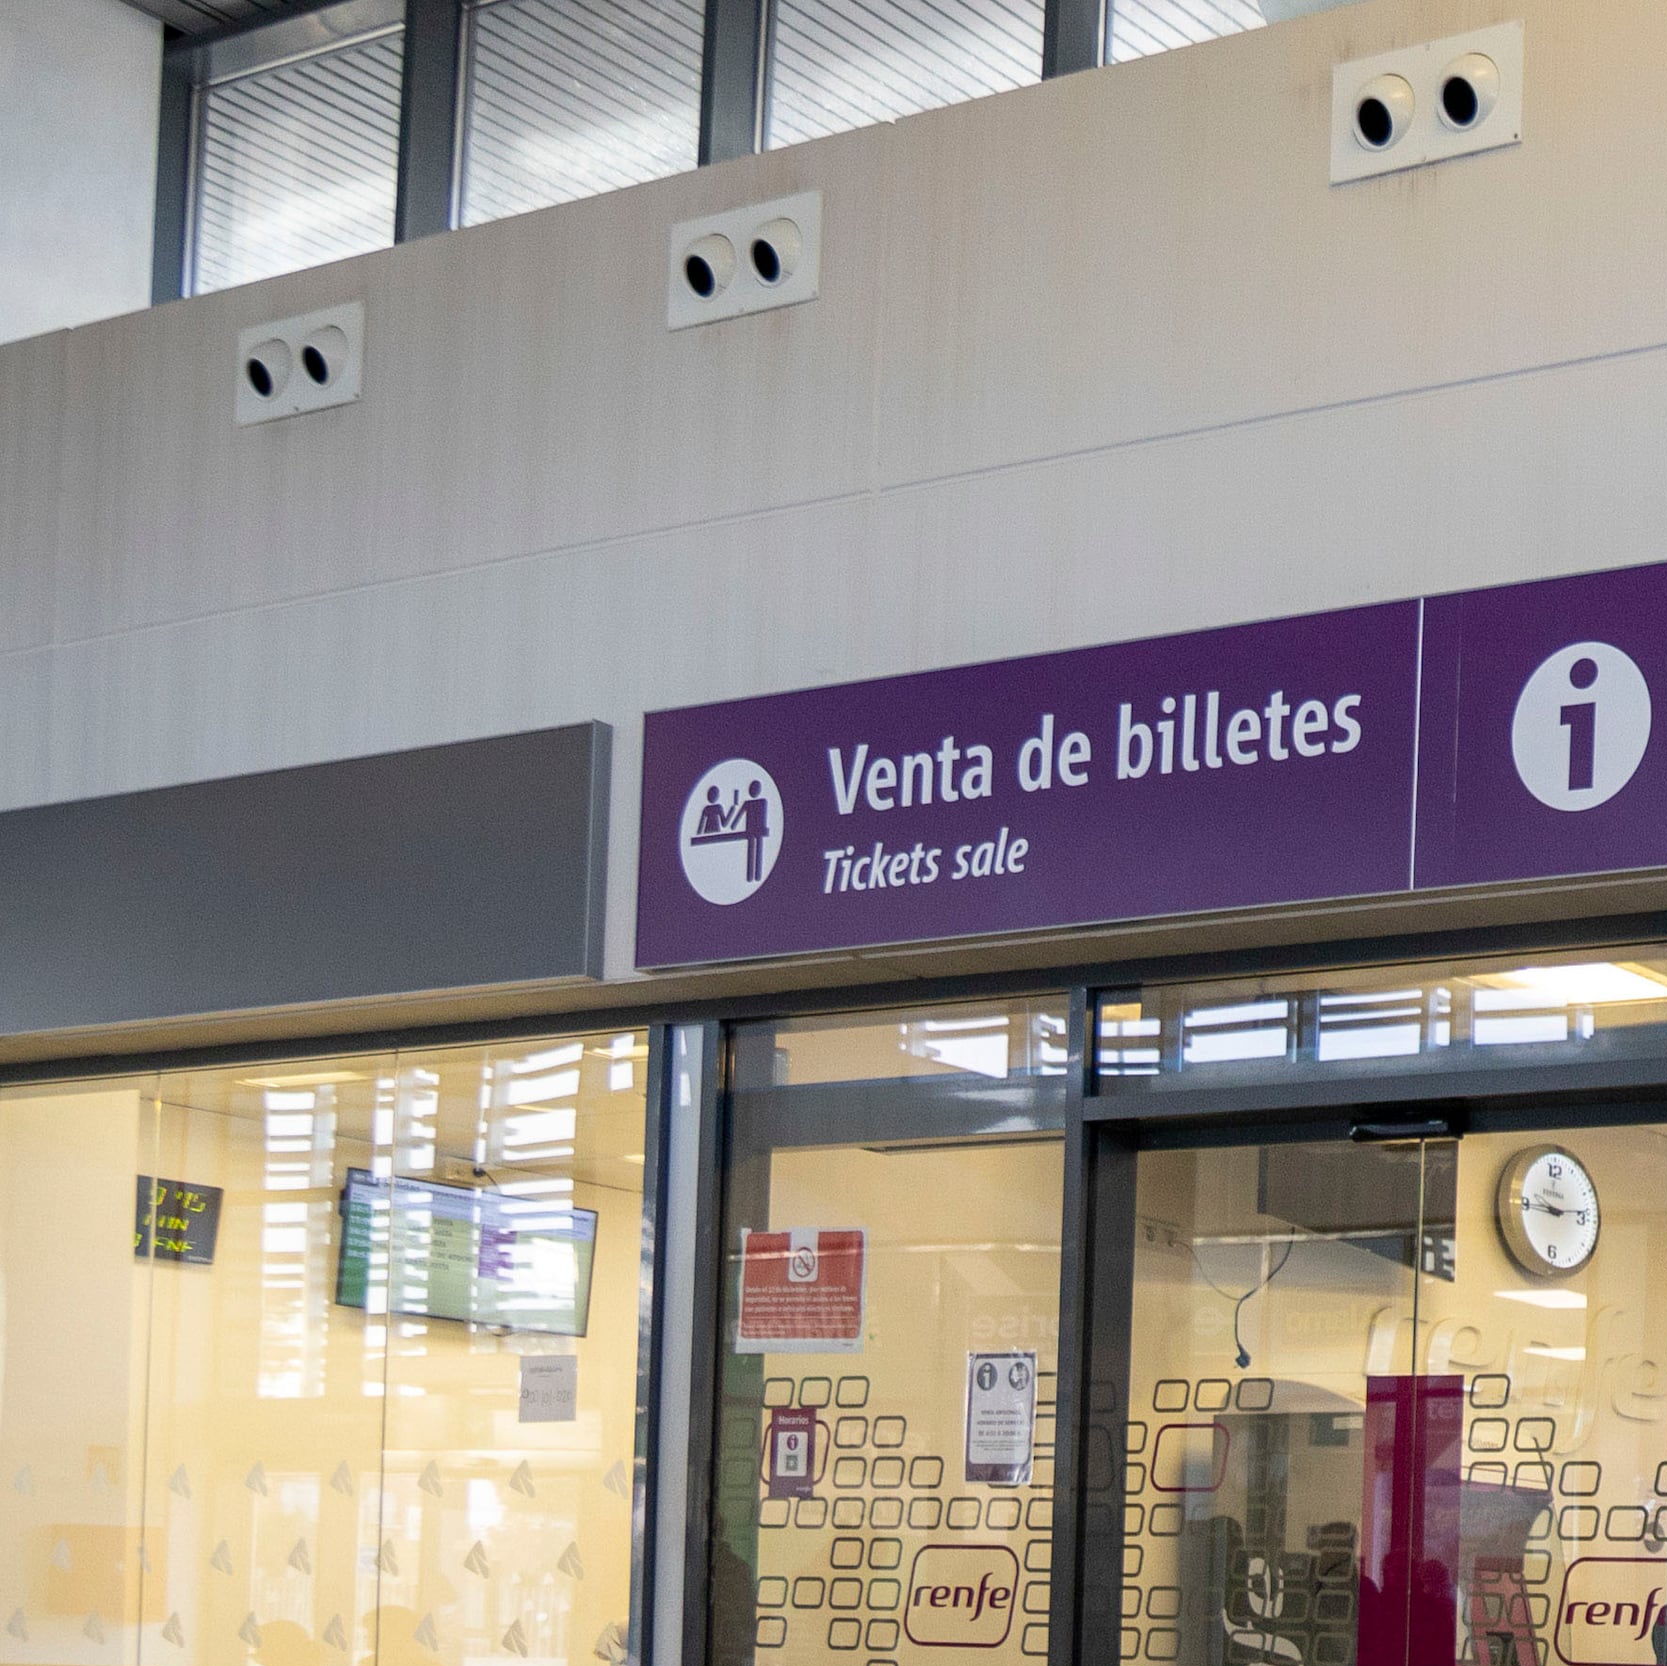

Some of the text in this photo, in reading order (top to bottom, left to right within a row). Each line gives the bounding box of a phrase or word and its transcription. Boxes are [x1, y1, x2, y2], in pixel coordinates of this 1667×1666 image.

[828, 691, 1364, 817] Venta de billetes
[823, 826, 1030, 894] Tickets sale
[1547, 1163, 1562, 1180] 12
[1576, 1211, 1586, 1226] 3
[1547, 1245, 1557, 1259] 6
[778, 1415, 809, 1425] Horarios
[913, 1572, 1011, 1622] renfe
